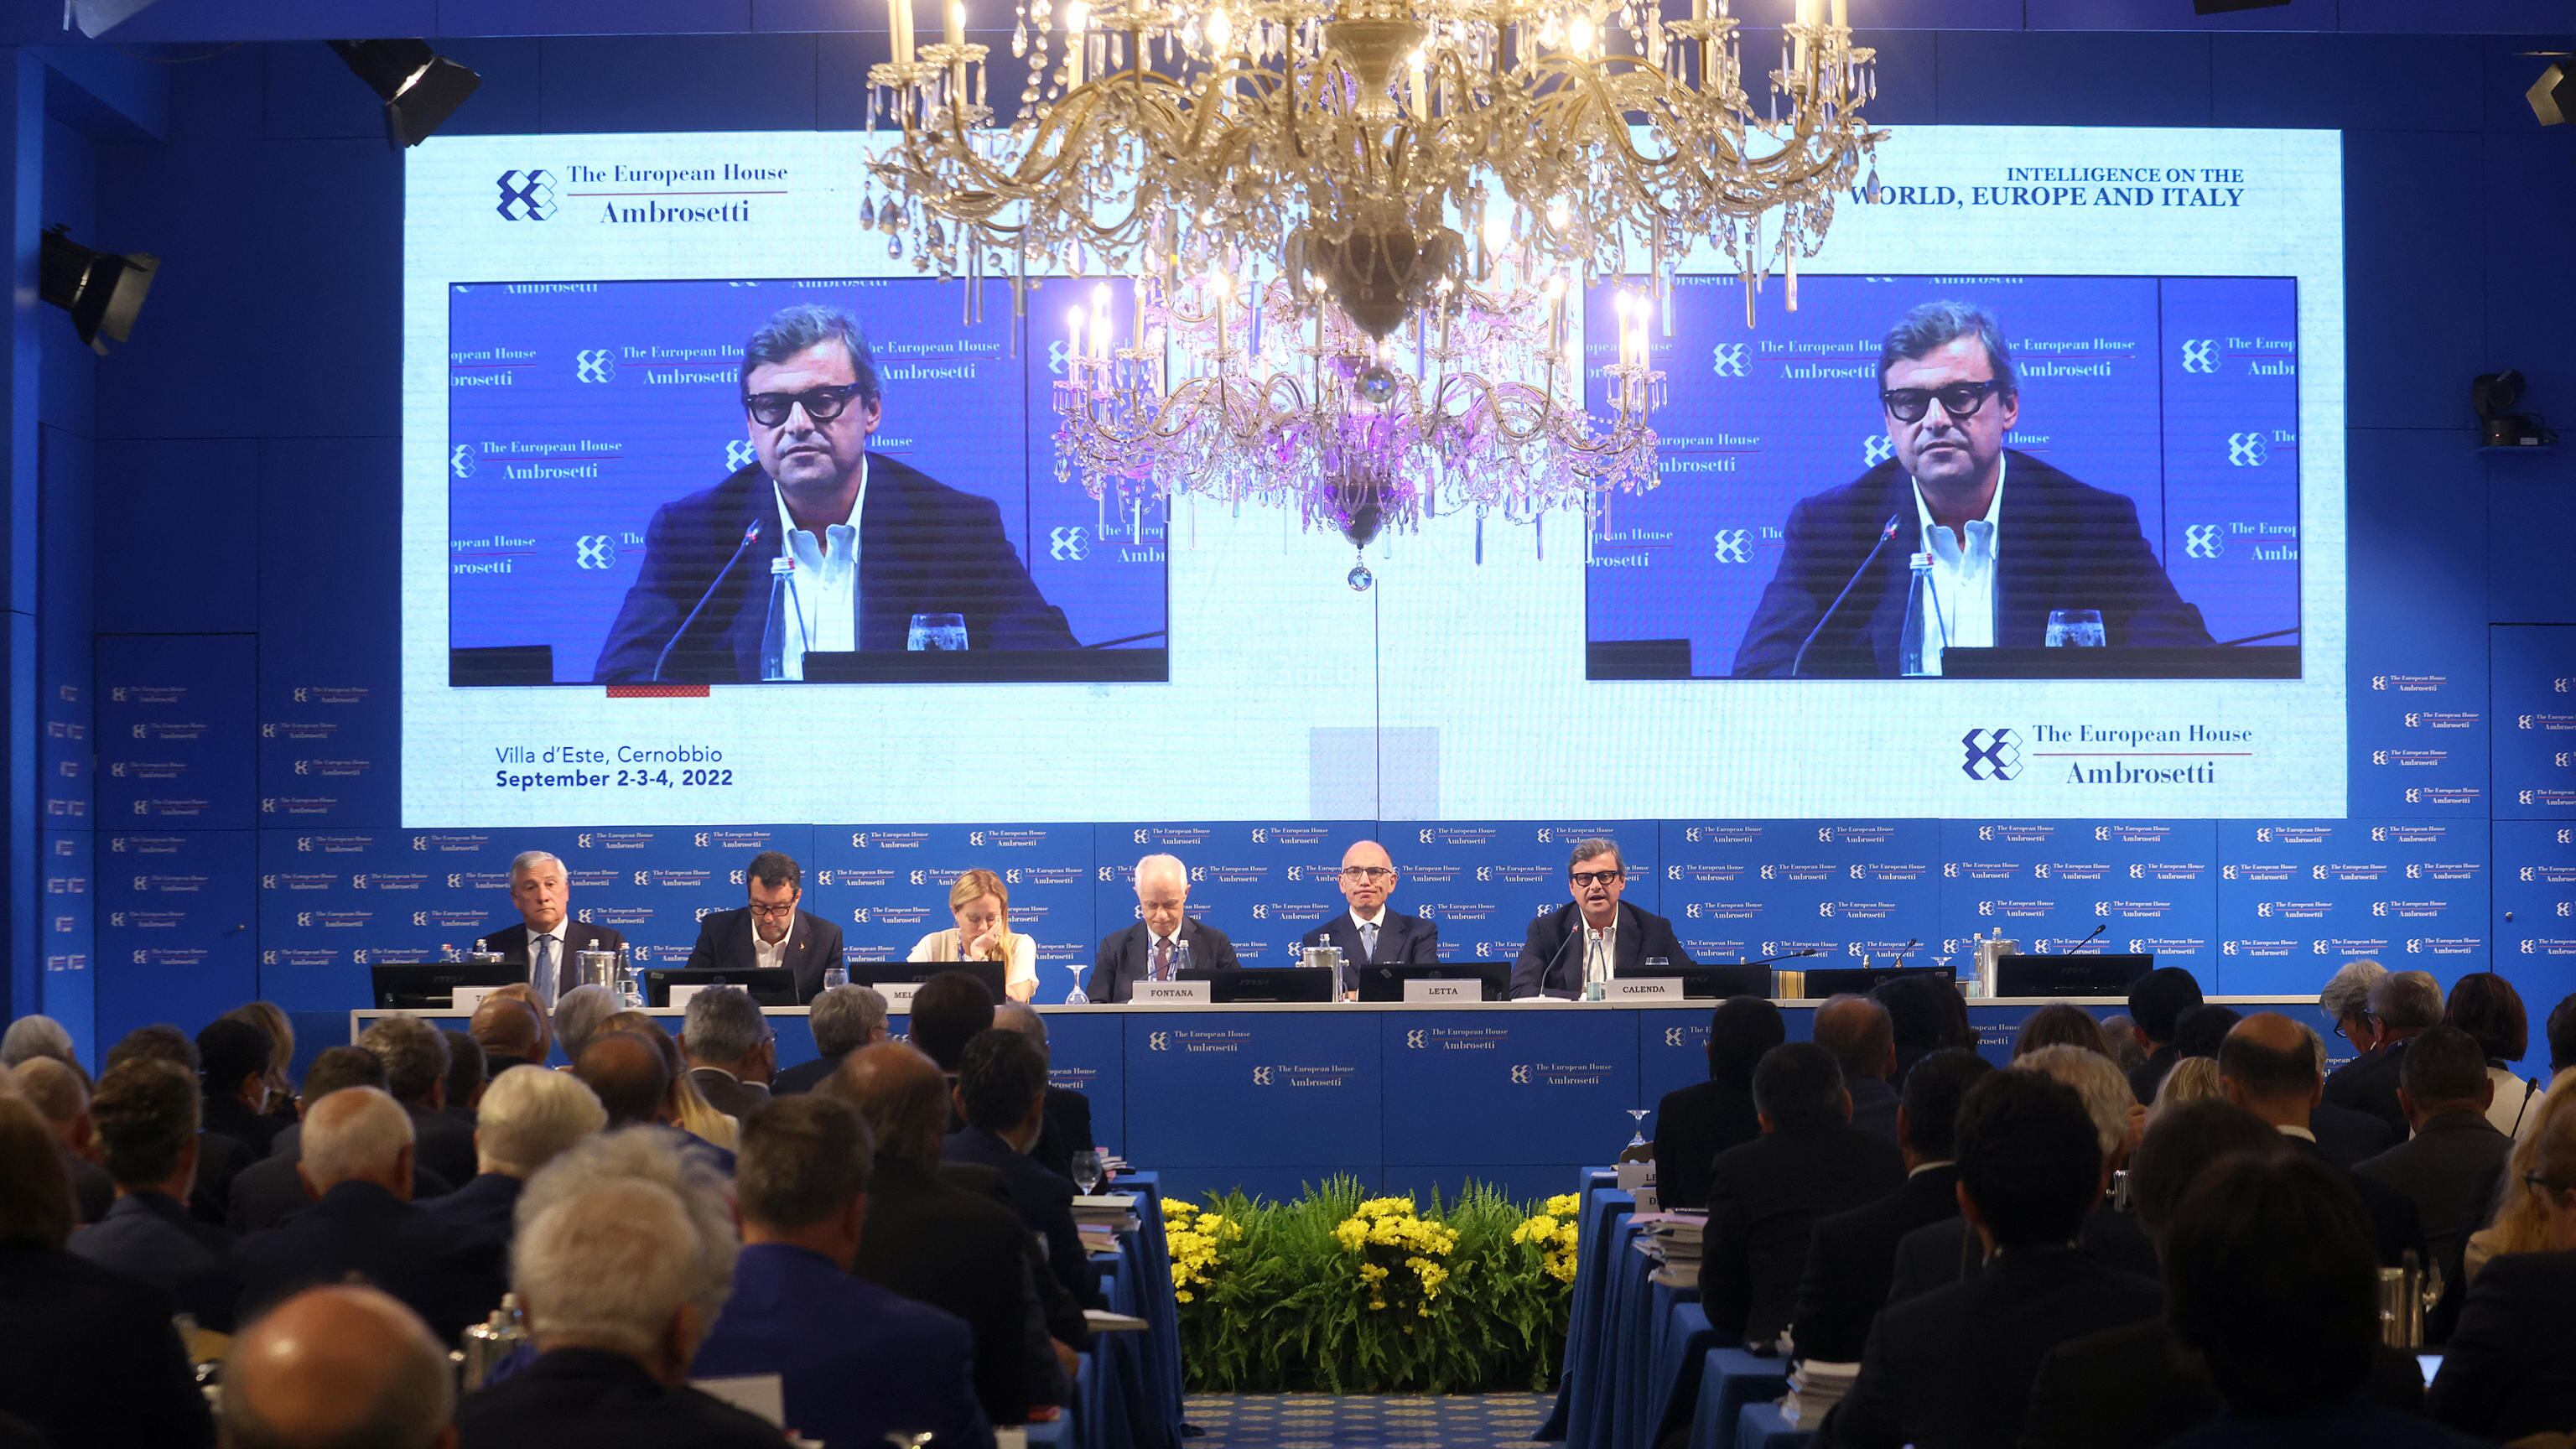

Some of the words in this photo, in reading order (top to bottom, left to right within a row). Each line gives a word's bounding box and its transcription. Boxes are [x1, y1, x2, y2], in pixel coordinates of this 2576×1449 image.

[567, 165, 606, 183] The
[614, 164, 716, 187] European
[722, 164, 788, 182] House
[2007, 168, 2161, 183] INTELLIGENCE
[2167, 169, 2197, 183] ON
[2200, 169, 2244, 183] THE
[1852, 186, 1964, 210] WORLD,
[1971, 186, 2086, 207] EUROPE
[2094, 187, 2154, 206] AND
[2161, 188, 2245, 207] ITALY
[600, 200, 750, 224] Ambrosetti
[621, 346, 647, 358] The
[652, 346, 717, 361] European
[721, 345, 745, 356] Hou
[888, 341, 954, 356] European
[958, 340, 1000, 352] House
[1758, 340, 1784, 352] The
[1789, 340, 1854, 356] European
[1858, 340, 1882, 351] Hou
[2024, 339, 2090, 354] European
[2093, 338, 2135, 350] House
[2226, 338, 2252, 350] The
[2256, 338, 2295, 353] Europ
[451, 350, 491, 361] opean
[495, 348, 537, 359] House
[643, 368, 739, 385] Ambrosetti
[880, 364, 976, 380] Ambrosetti
[1780, 363, 1876, 379] Ambrosetti
[2018, 361, 2111, 377] Ambrosetti
[451, 371, 512, 386] brosetti
[871, 435, 912, 448] House
[1659, 435, 1714, 449] uropean
[1718, 434, 1760, 445] House
[2008, 432, 2049, 444] House
[2272, 430, 2295, 442] The
[481, 442, 507, 454] The
[511, 441, 577, 456] European
[580, 440, 622, 452] House
[503, 463, 598, 480] Ambrosetti
[1659, 457, 1736, 473] mbrosetti
[1632, 528, 1673, 541] House
[1760, 527, 1784, 539] The
[2229, 522, 2255, 534] The
[2259, 523, 2298, 538] Europ
[451, 538, 491, 550] opean
[494, 536, 536, 548] House
[621, 532, 644, 544] The
[1590, 553, 1649, 568] brosetti
[2033, 725, 2073, 742] The
[2080, 725, 2180, 747] European
[2189, 724, 2252, 742] House
[496, 746, 535, 763] Villa
[543, 746, 610, 766] d'Este,
[617, 745, 722, 763] Cernobbio
[2066, 761, 2215, 784] Ambrosetti
[496, 770, 610, 792] September
[617, 770, 673, 788] 2-3-4,
[682, 770, 733, 786] 2022
[880, 840, 919, 849] Ambrosetti
[998, 839, 1036, 847] Ambrosetti
[1623, 985, 1665, 994] CALENDA
[1190, 1031, 1226, 1040] European
[1447, 1028, 1483, 1036] European
[1186, 1043, 1238, 1052] Ambrosetti
[1444, 1041, 1495, 1050] Ambrosetti
[1294, 1066, 1330, 1074] European
[1552, 1063, 1587, 1072] European
[1048, 1081, 1083, 1089] brosetti
[1291, 1078, 1342, 1087] Ambrosetti
[1548, 1076, 1599, 1085] Ambrosetti
